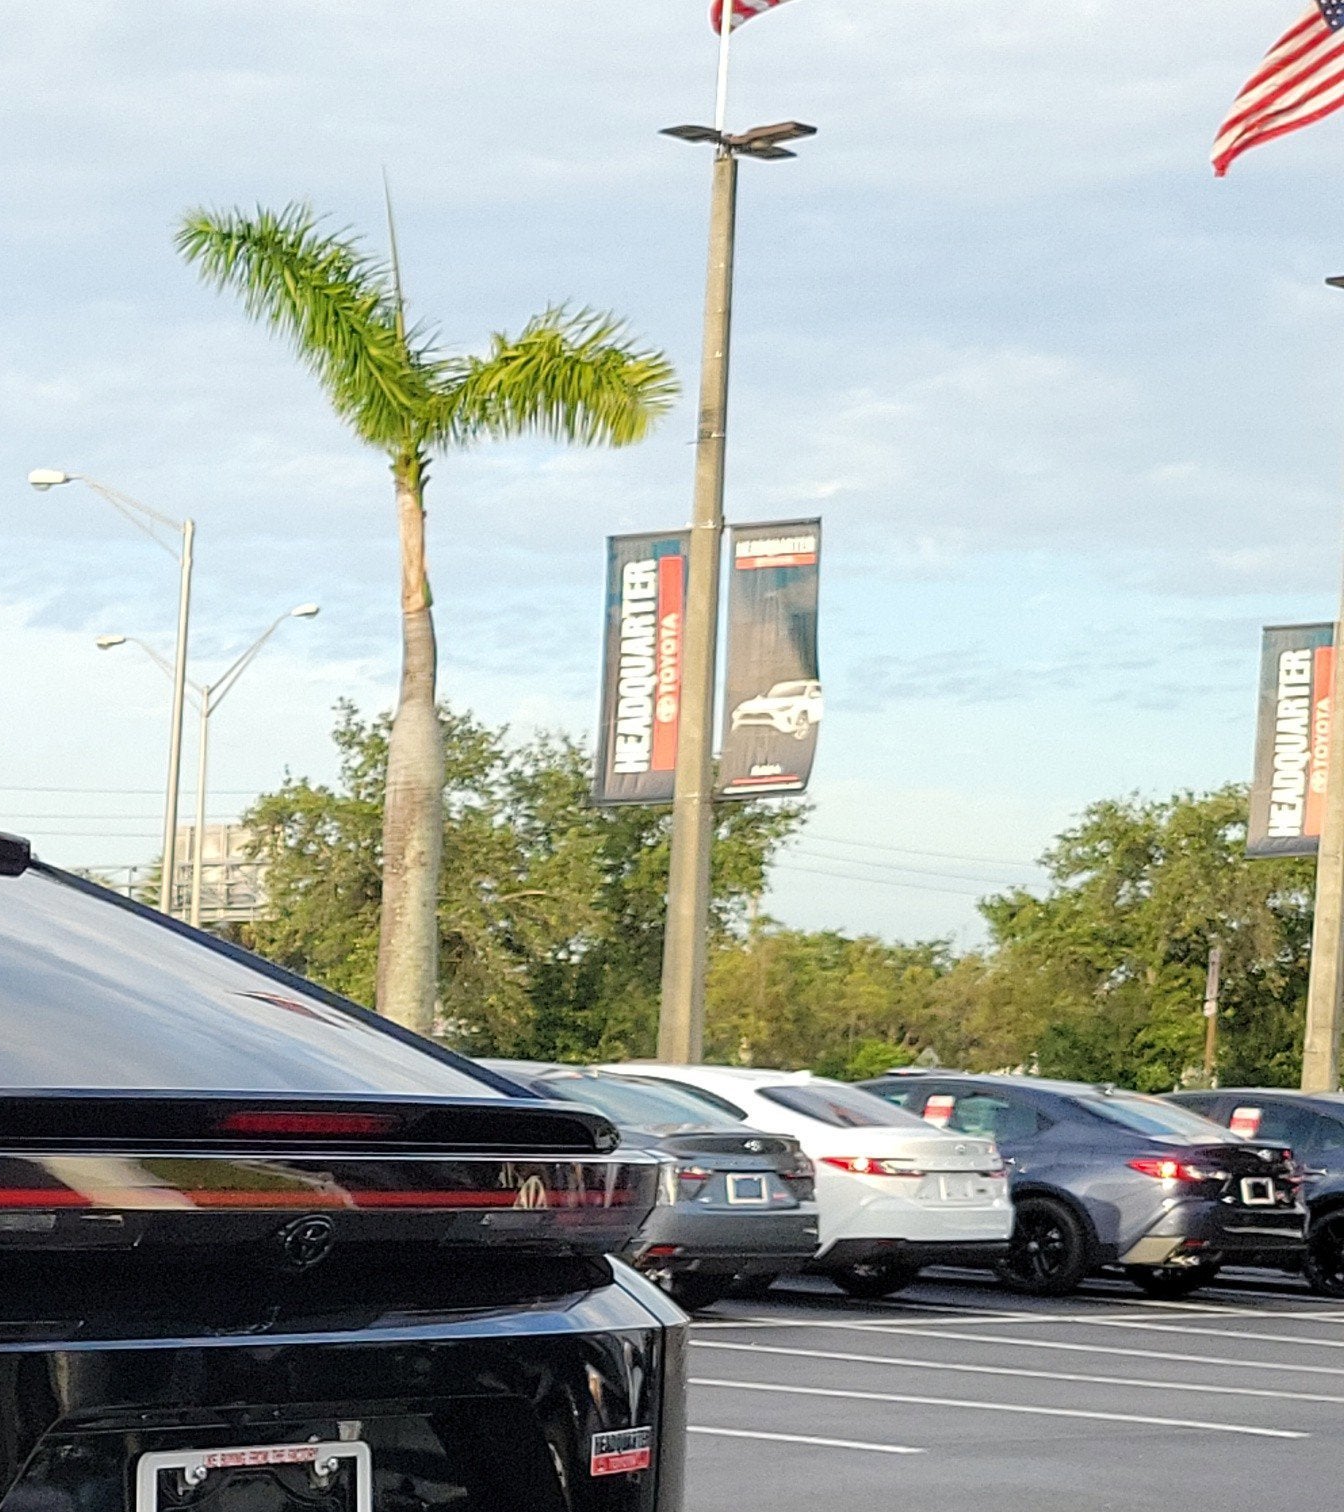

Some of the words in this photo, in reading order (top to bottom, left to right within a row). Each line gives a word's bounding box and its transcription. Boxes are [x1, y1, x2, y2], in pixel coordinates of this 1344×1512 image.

[614, 558, 657, 773] HEADQUARTER
[659, 612, 679, 696] TOYOTA
[1268, 649, 1311, 837] HEADQUARTER
